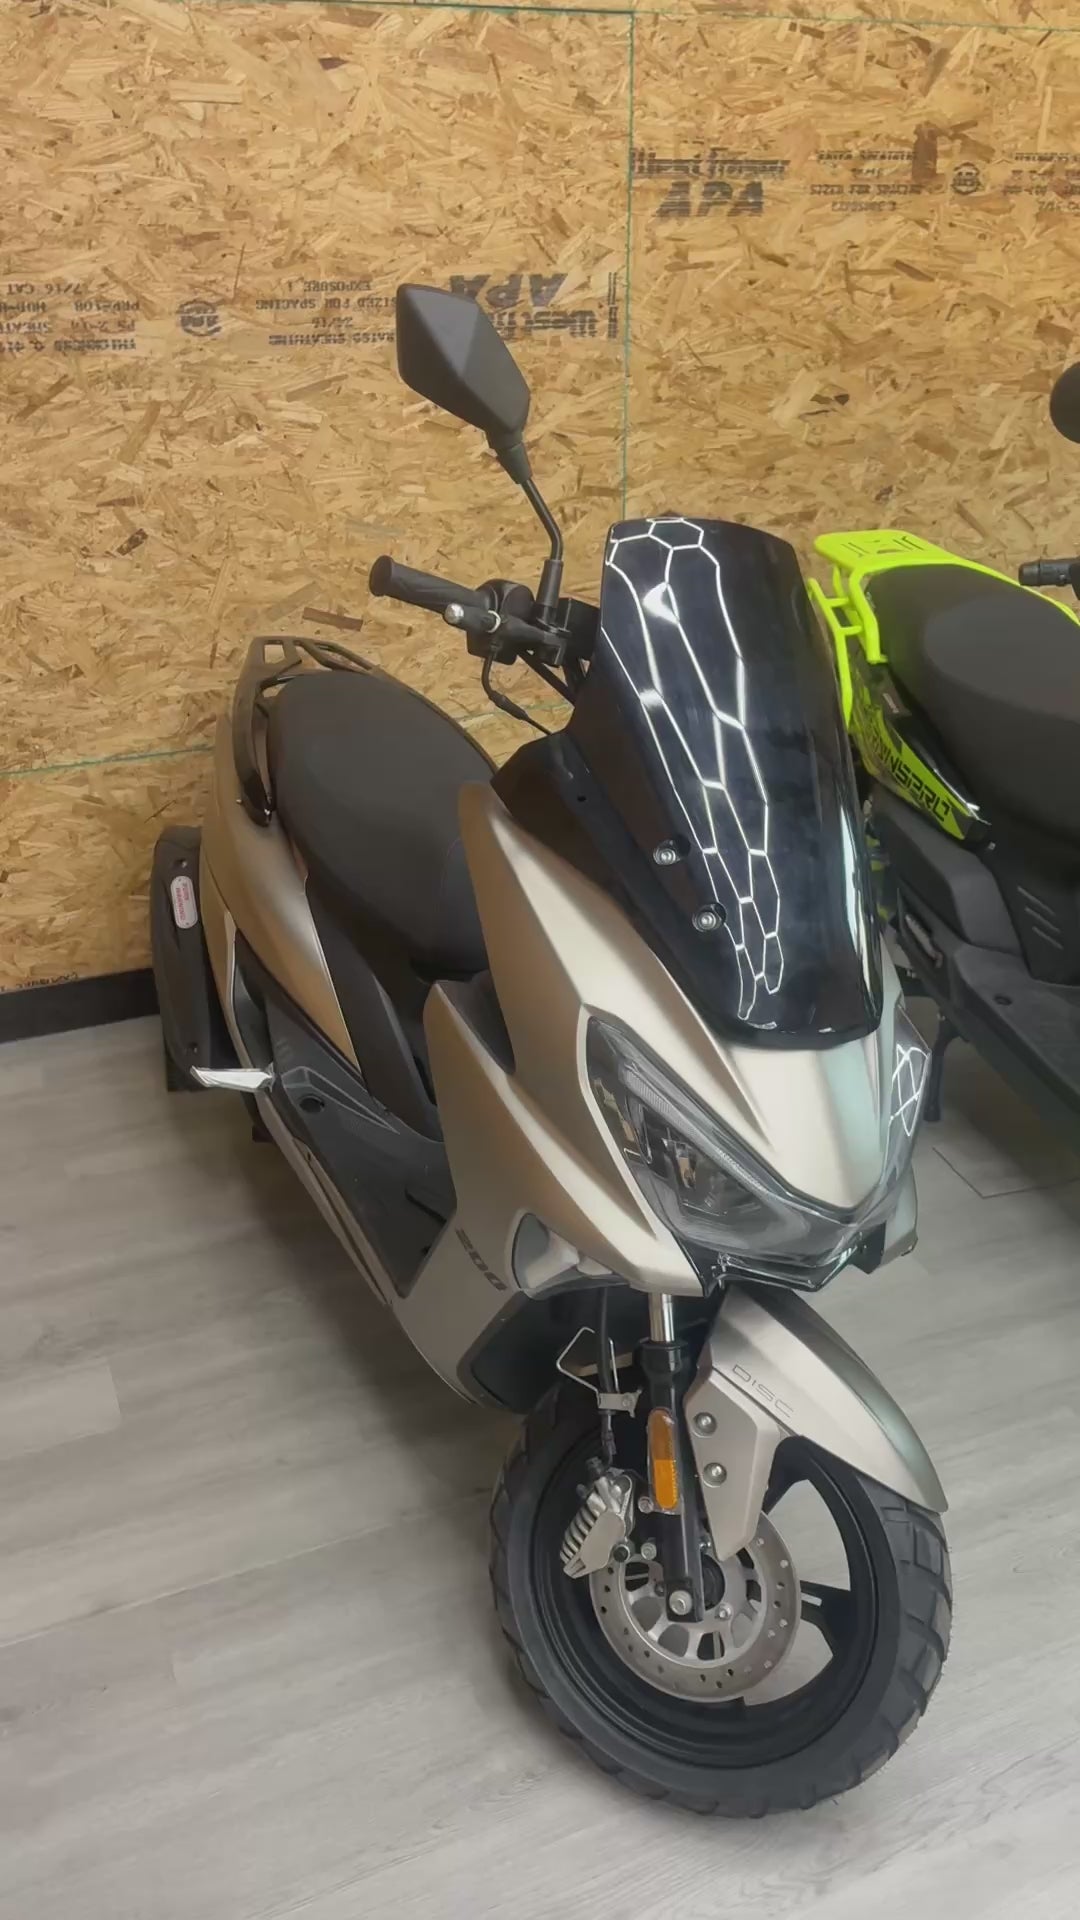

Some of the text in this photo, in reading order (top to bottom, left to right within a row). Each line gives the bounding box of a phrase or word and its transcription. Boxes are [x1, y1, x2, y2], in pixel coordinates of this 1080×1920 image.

[651, 181, 765, 218] APA
[7, 283, 82, 295] 7/16 CAT
[303, 280, 371, 292] EXPOSURE
[449, 273, 569, 307] APA
[255, 299, 316, 310] SPACING
[324, 298, 350, 309] FOR
[732, 1364, 794, 1419] DISC
